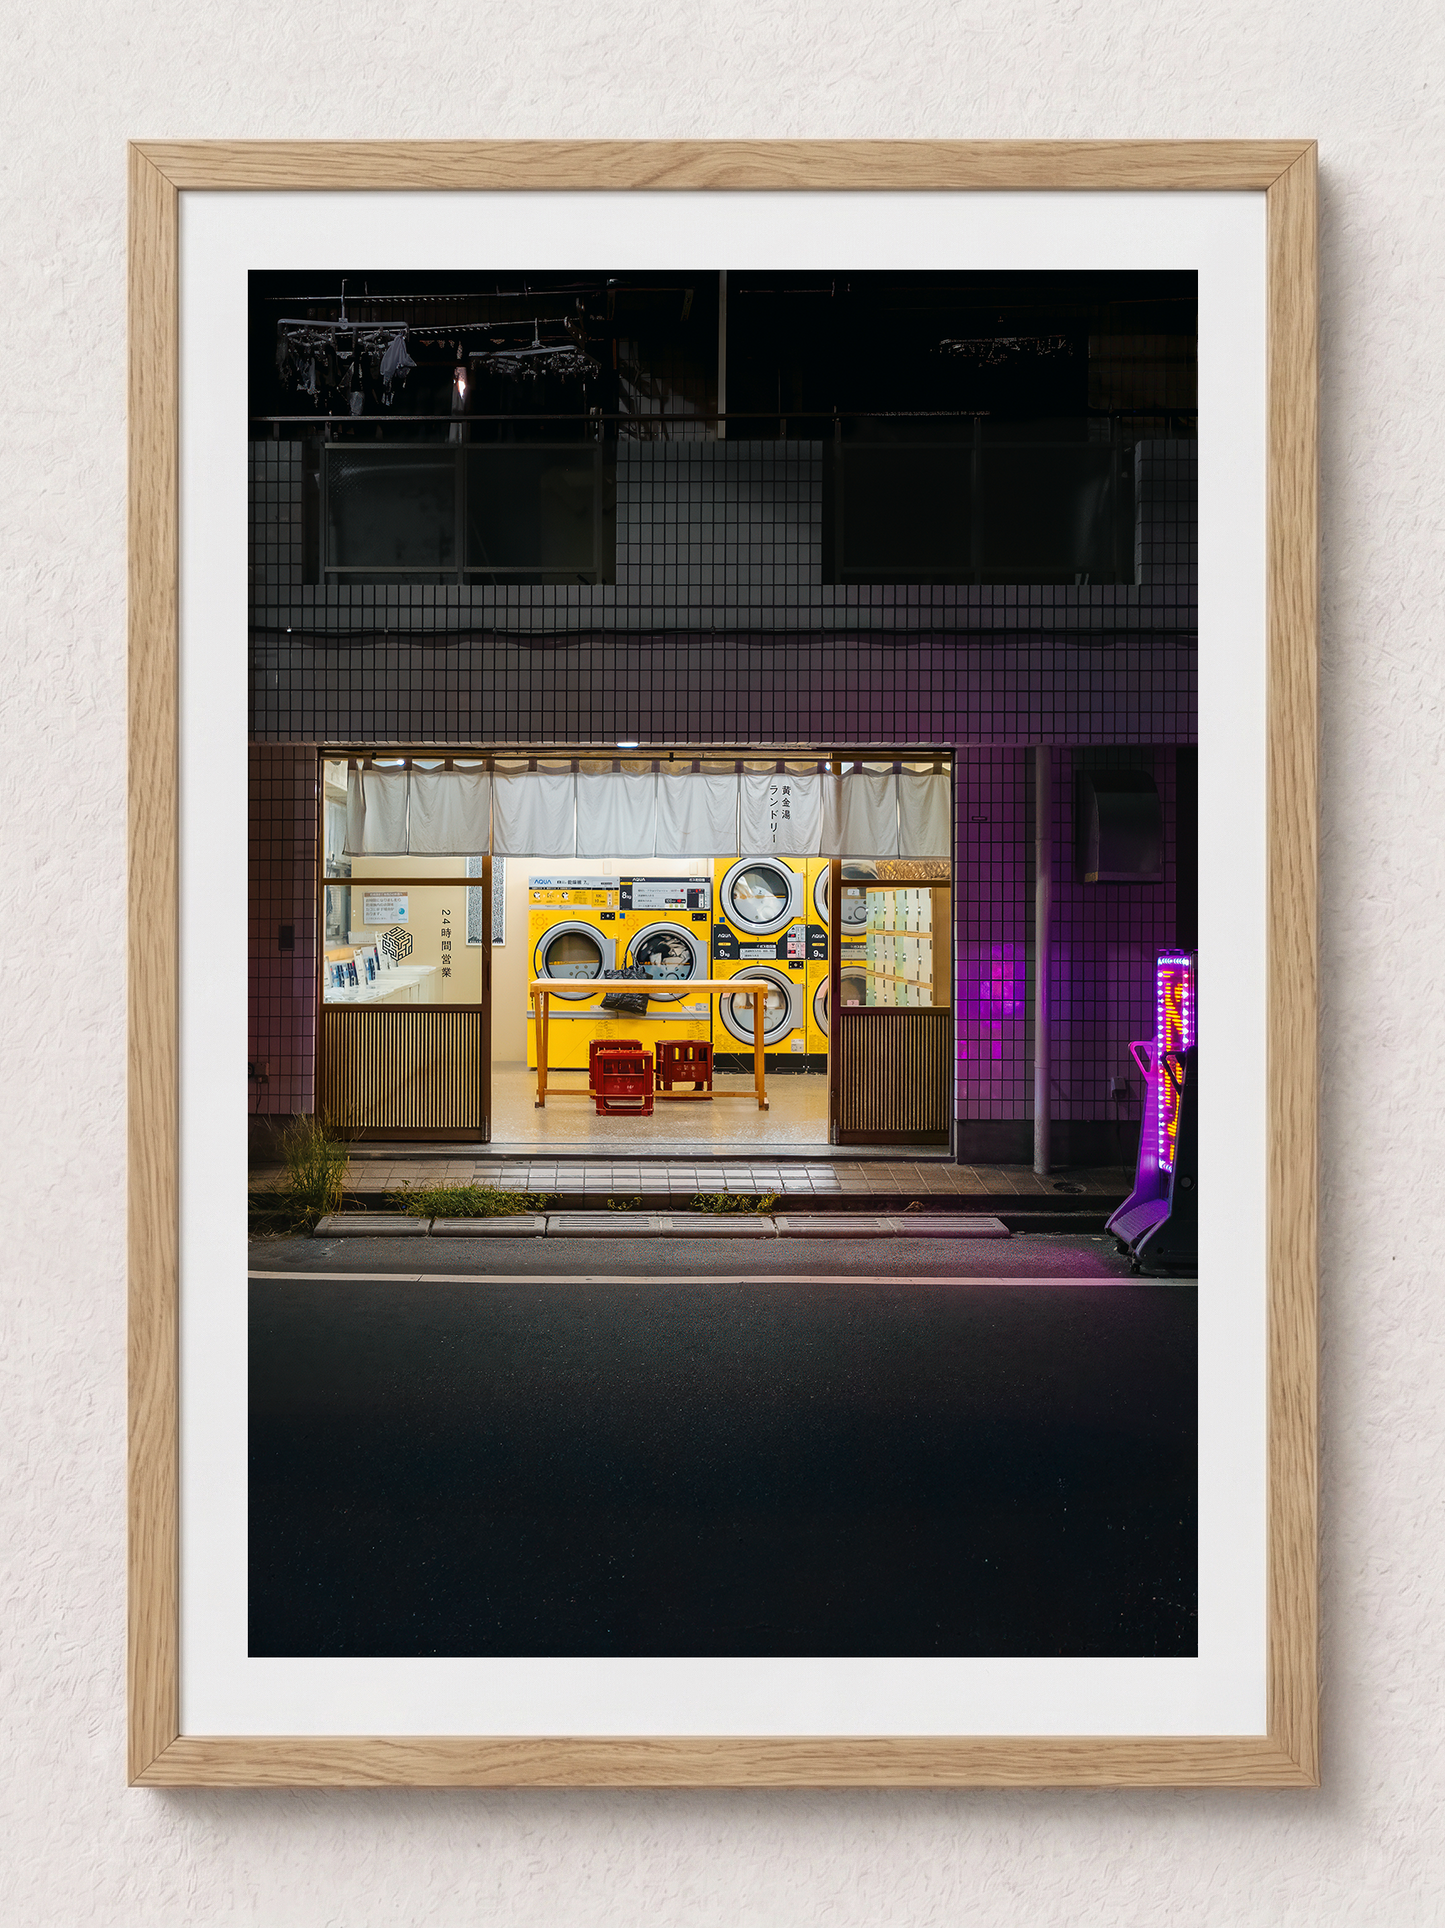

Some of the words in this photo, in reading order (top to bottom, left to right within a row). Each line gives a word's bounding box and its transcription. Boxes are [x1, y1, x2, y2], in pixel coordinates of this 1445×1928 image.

[769, 784, 779, 843] ランドリー
[781, 785, 791, 820] 黄金湯
[441, 909, 452, 978] 24時間営業
[719, 949, 731, 958] 9kg
[813, 949, 824, 958] 9kg
